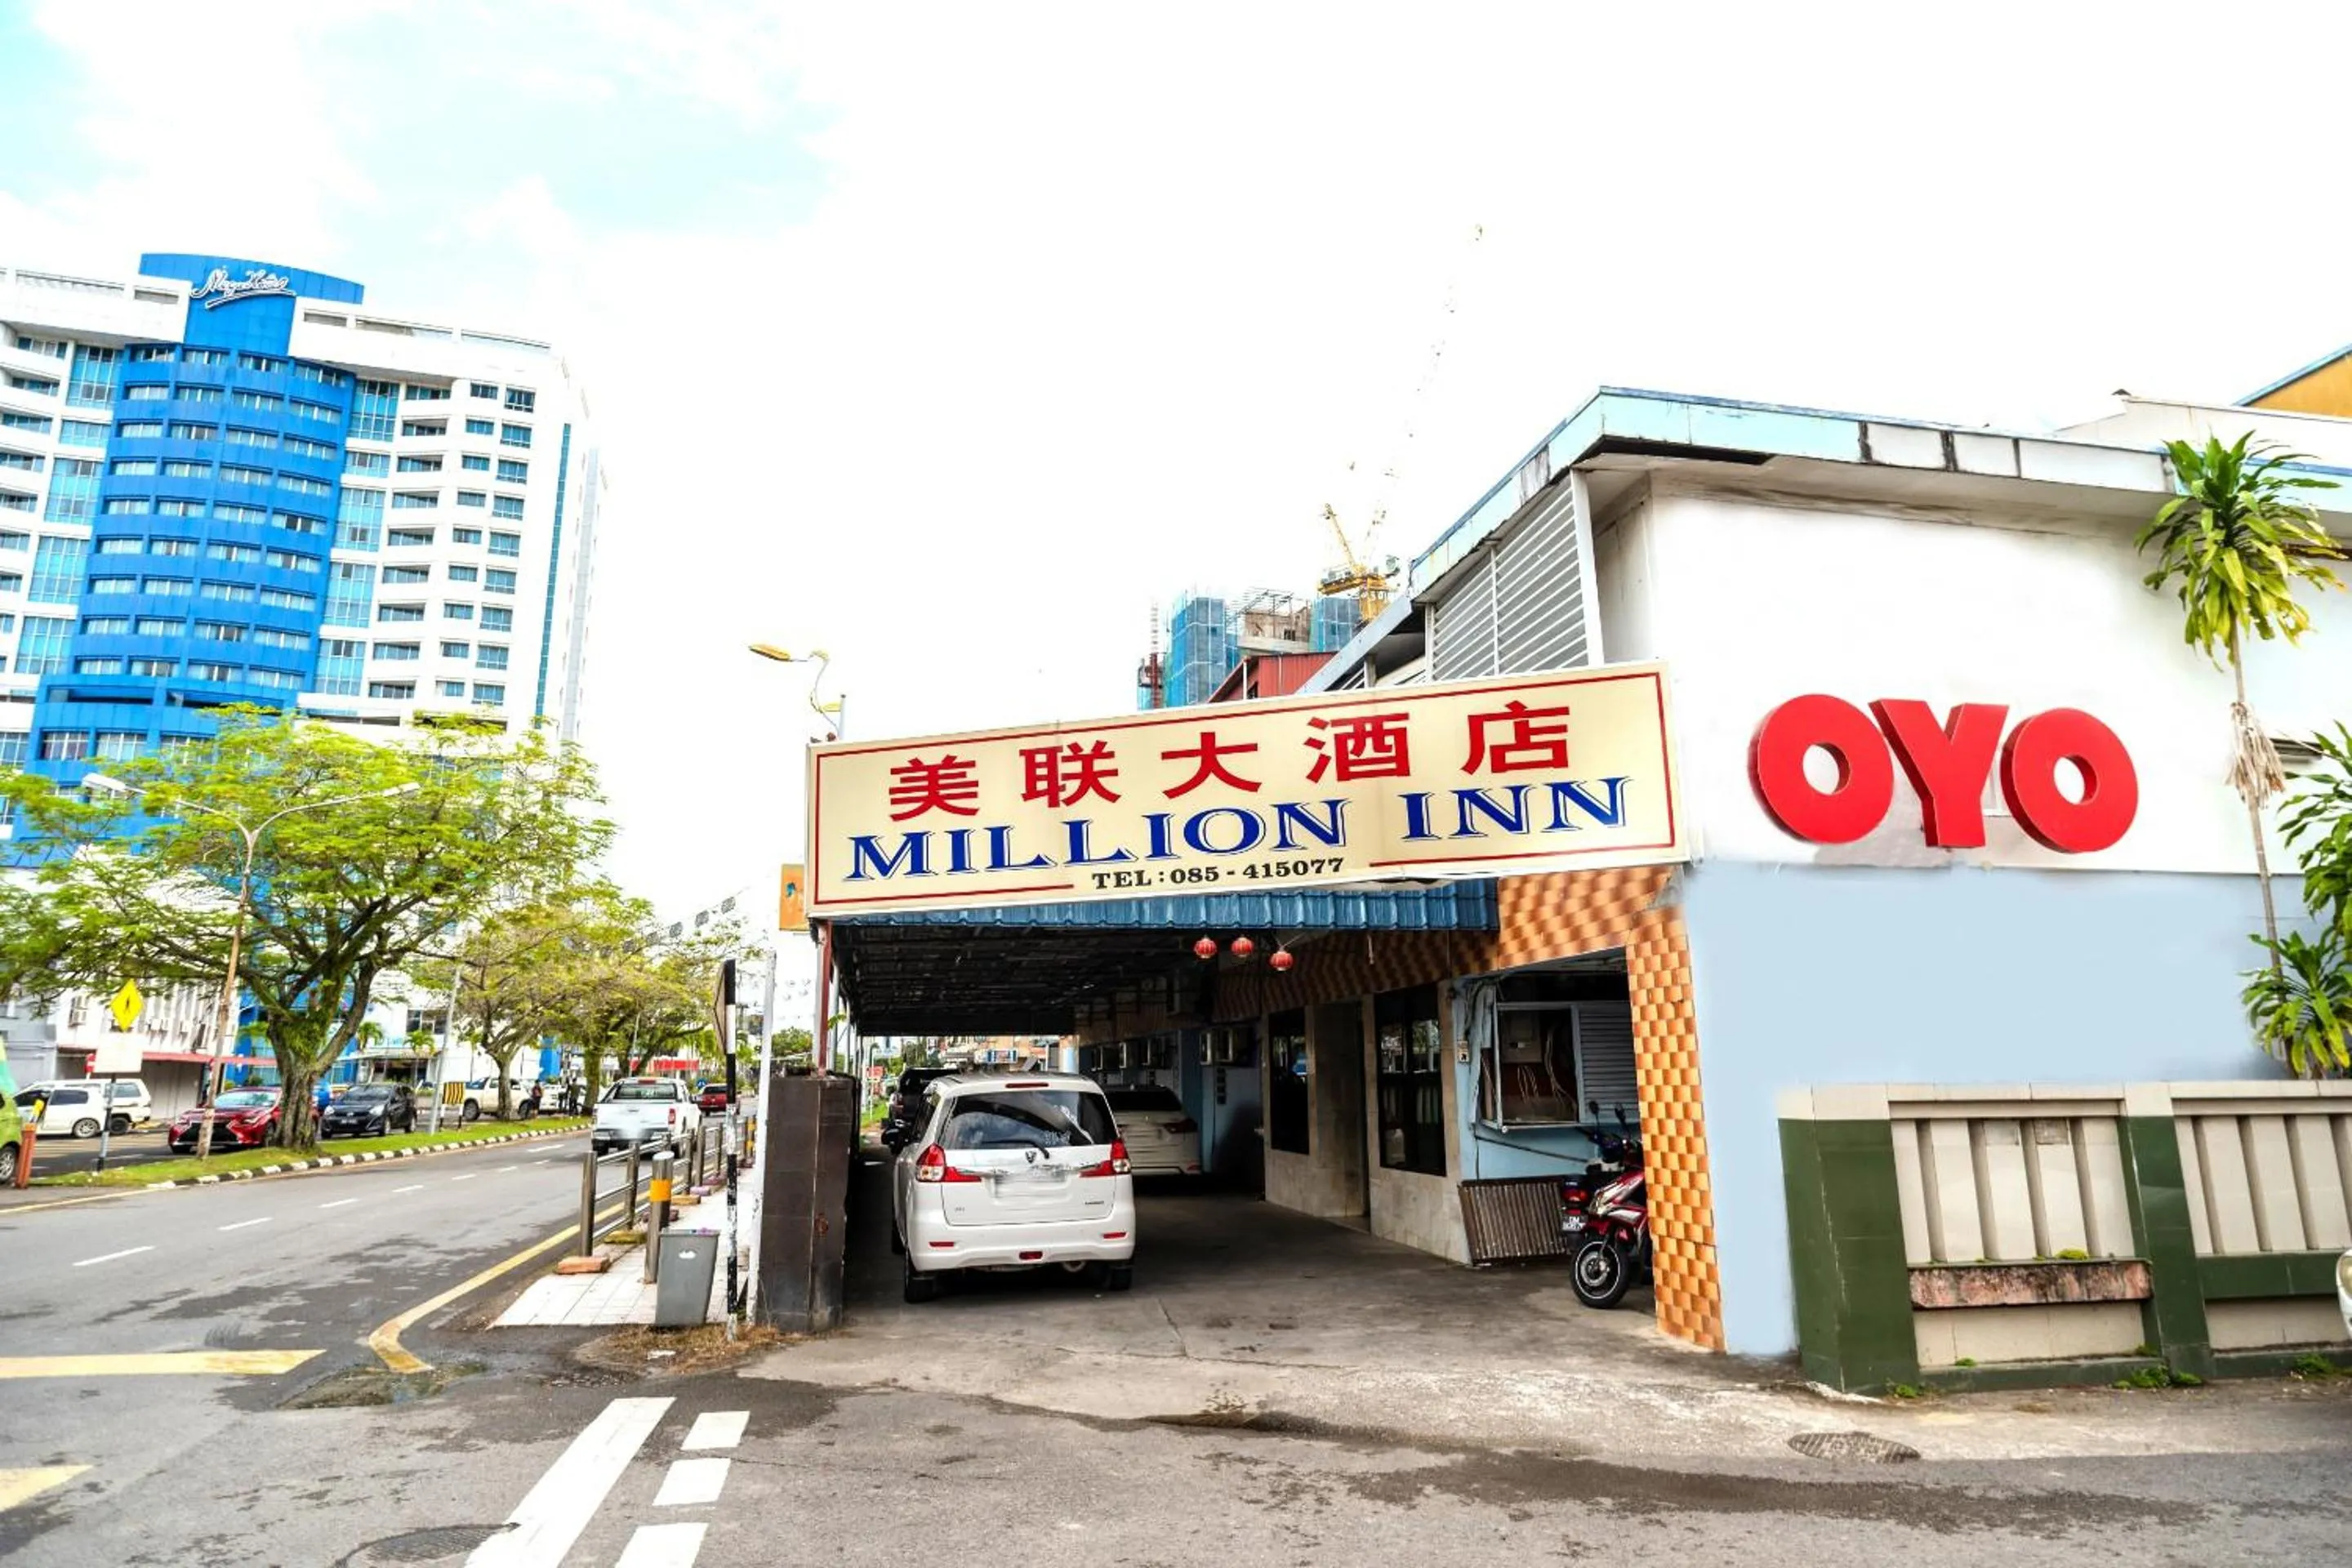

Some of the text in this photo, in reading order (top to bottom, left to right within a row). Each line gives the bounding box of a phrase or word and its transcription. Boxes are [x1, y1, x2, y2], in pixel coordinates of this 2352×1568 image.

[888, 699, 1570, 822] 美联大酒店
[1747, 693, 2139, 854] OYO
[843, 775, 1633, 883] MILLION INN
